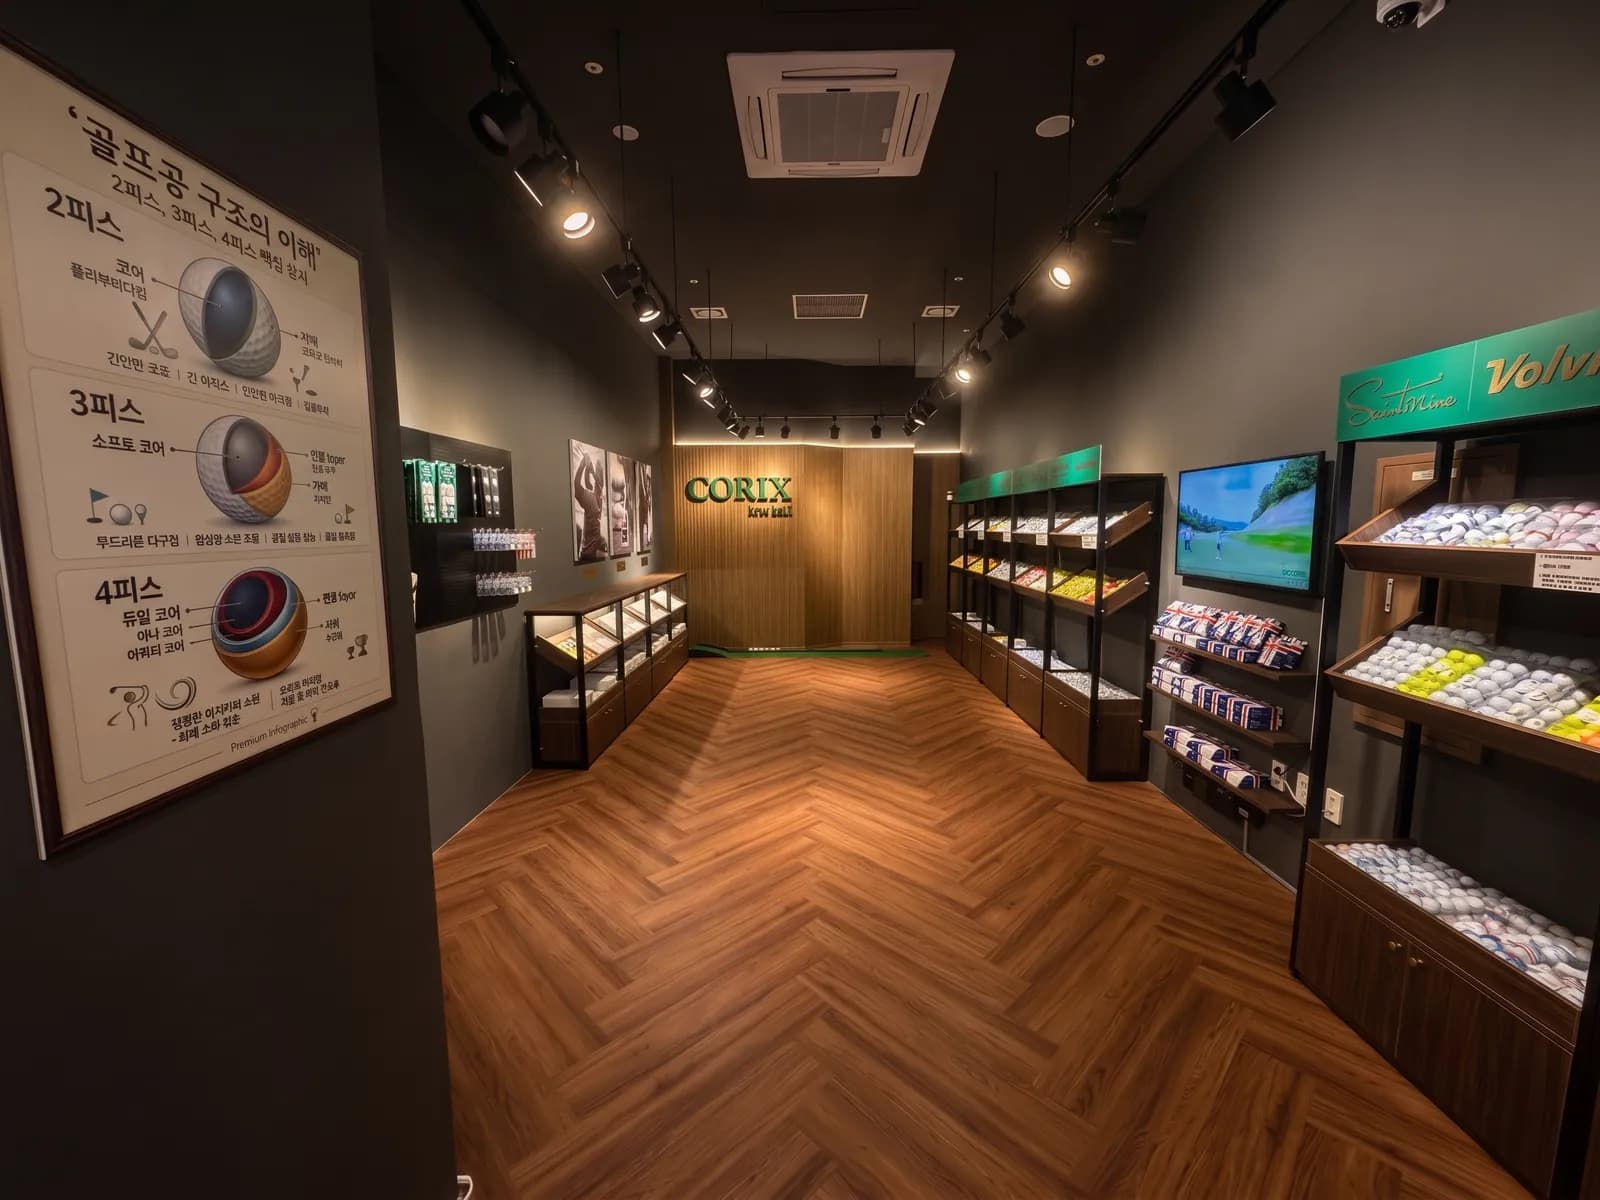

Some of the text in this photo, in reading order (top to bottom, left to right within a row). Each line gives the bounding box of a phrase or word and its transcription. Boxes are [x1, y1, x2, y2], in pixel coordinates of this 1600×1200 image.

[44, 187, 125, 242] 2피스
[198, 182, 270, 246] 구조의
[221, 231, 257, 260] 4피스
[116, 257, 145, 284] 코어
[69, 389, 145, 424] 3피스
[139, 439, 166, 457] 코어
[684, 476, 792, 504] CORIX
[95, 576, 164, 605] 4피스
[122, 604, 181, 628] 듀일 코어
[137, 623, 184, 642] 아나 코어
[164, 639, 185, 654] 코어
